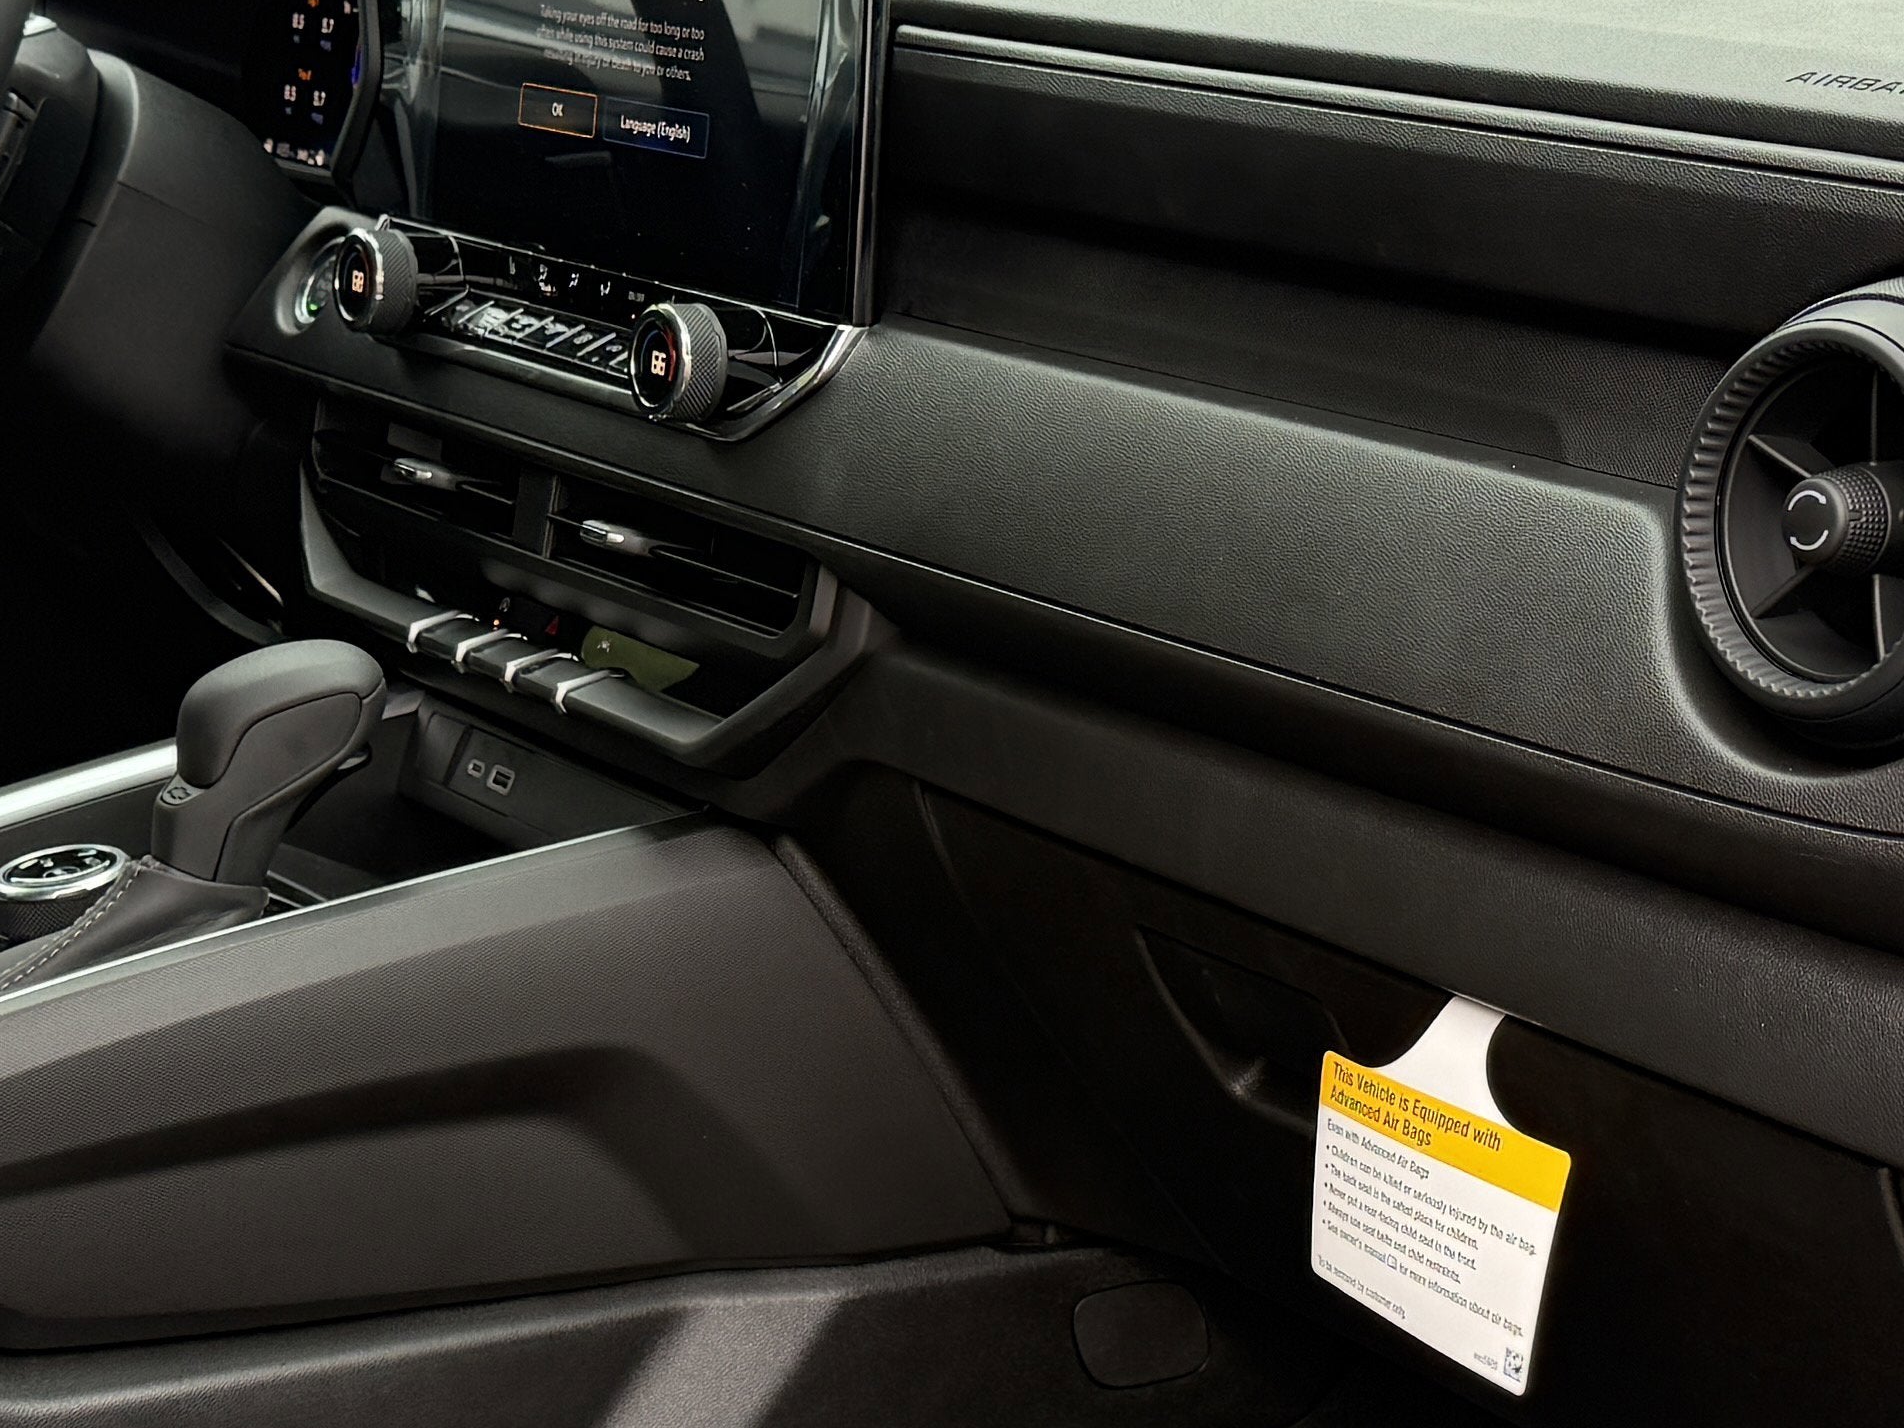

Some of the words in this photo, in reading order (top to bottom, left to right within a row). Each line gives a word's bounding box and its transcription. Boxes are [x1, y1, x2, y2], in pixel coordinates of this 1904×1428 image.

[556, 26, 573, 43] while
[575, 32, 593, 48] using
[595, 33, 607, 48] this
[608, 36, 634, 53] system
[634, 39, 654, 54] could
[656, 45, 676, 58] cause
[678, 48, 683, 59] a
[683, 47, 705, 62] crash
[562, 11, 577, 25] your
[579, 13, 595, 27] eyes
[596, 12, 607, 26] off
[608, 15, 619, 29] the
[620, 15, 637, 31] road
[638, 18, 649, 33] for
[650, 22, 662, 34] too
[664, 21, 680, 41] long
[682, 27, 690, 39] or
[691, 26, 705, 41] too
[656, 65, 665, 76] or
[551, 102, 564, 117] OK
[620, 115, 657, 137] Language
[657, 121, 691, 143] (English)
[1330, 1084, 1381, 1123] Advanced
[1383, 1110, 1400, 1132] Air
[1402, 1119, 1432, 1147] Bags
[1333, 1061, 1354, 1087] This
[1357, 1073, 1396, 1106] Vehicle
[1399, 1093, 1409, 1112] is
[1412, 1099, 1471, 1138] Equipped
[1473, 1125, 1502, 1152] with
[1327, 1118, 1344, 1137] Even
[1345, 1130, 1360, 1145] with
[1361, 1136, 1396, 1164] Advanced
[1397, 1154, 1409, 1169] Air
[1331, 1145, 1358, 1167] Children
[1359, 1162, 1372, 1174] can
[1372, 1166, 1382, 1180] be
[1403, 1185, 1412, 1195] or
[1413, 1189, 1447, 1215] seriously
[1449, 1204, 1477, 1227] injured
[1477, 1217, 1489, 1235] by
[1490, 1223, 1504, 1240] the
[1505, 1232, 1518, 1245] air
